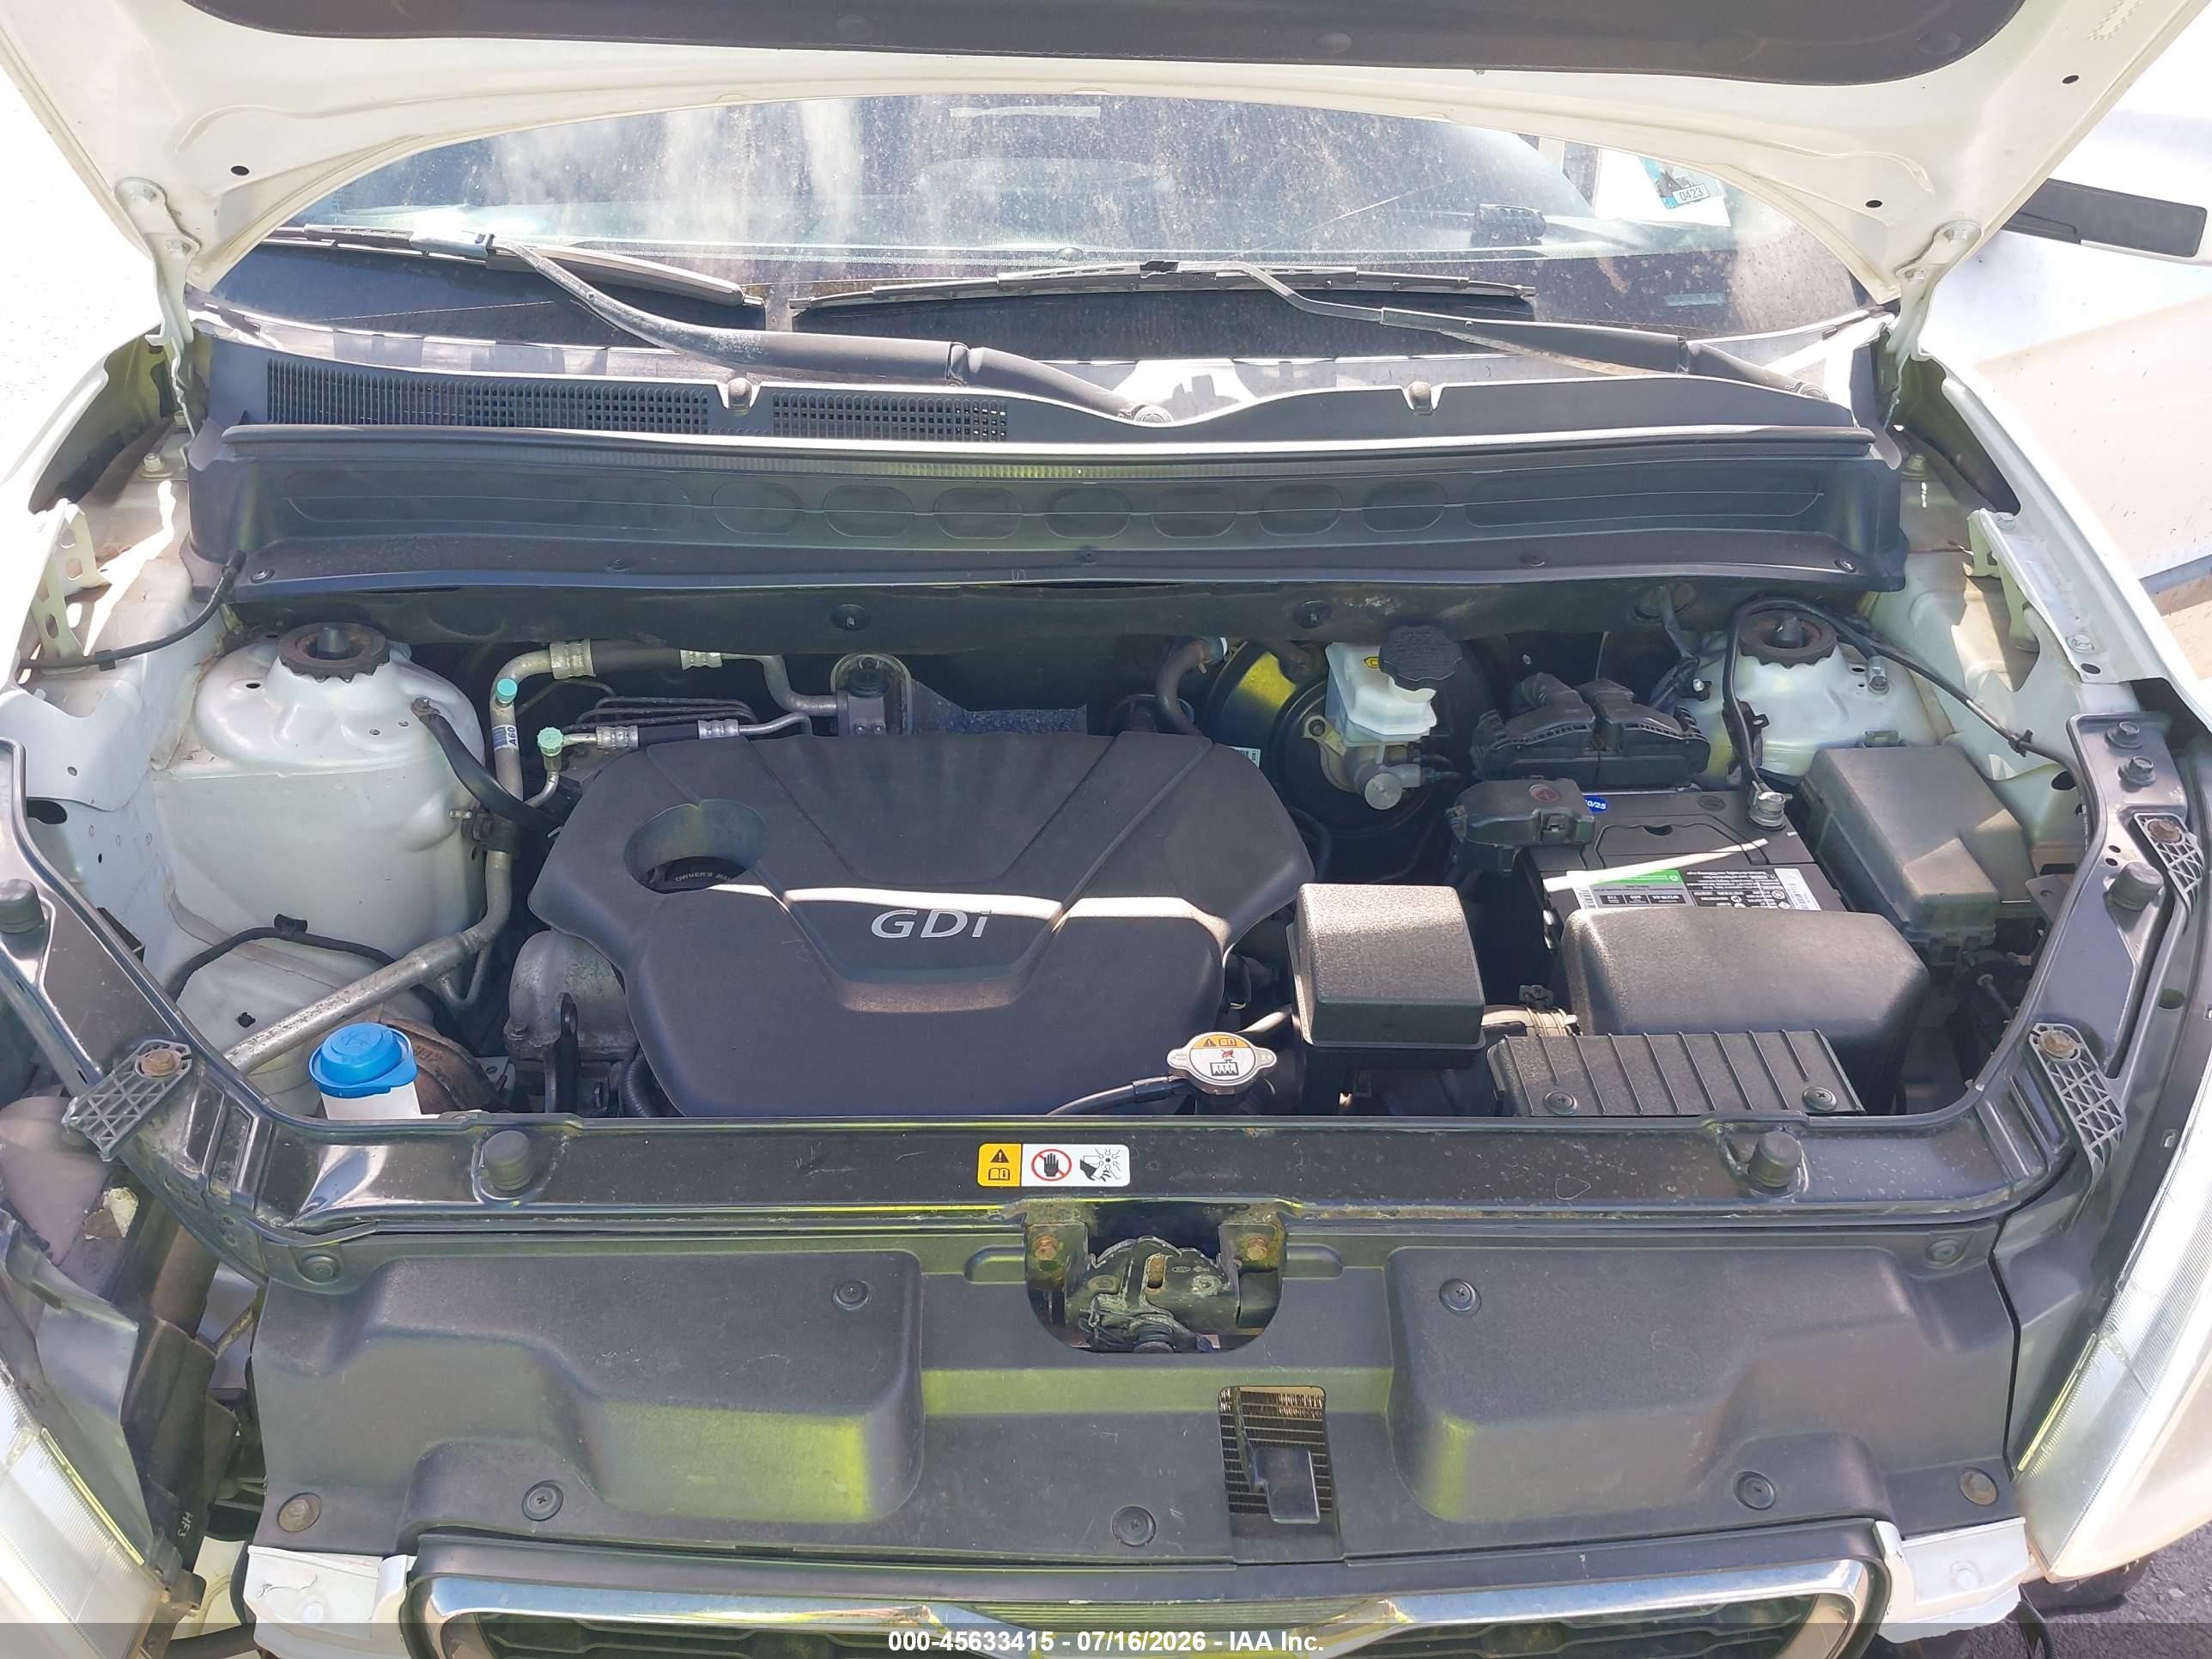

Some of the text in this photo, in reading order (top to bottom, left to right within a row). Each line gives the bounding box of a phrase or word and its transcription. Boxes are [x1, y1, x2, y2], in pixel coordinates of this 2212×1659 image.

[1679, 187, 1704, 201] 0423
[507, 726, 517, 746] A60
[1585, 799, 1607, 810] 0/25
[871, 908, 992, 939] GDi
